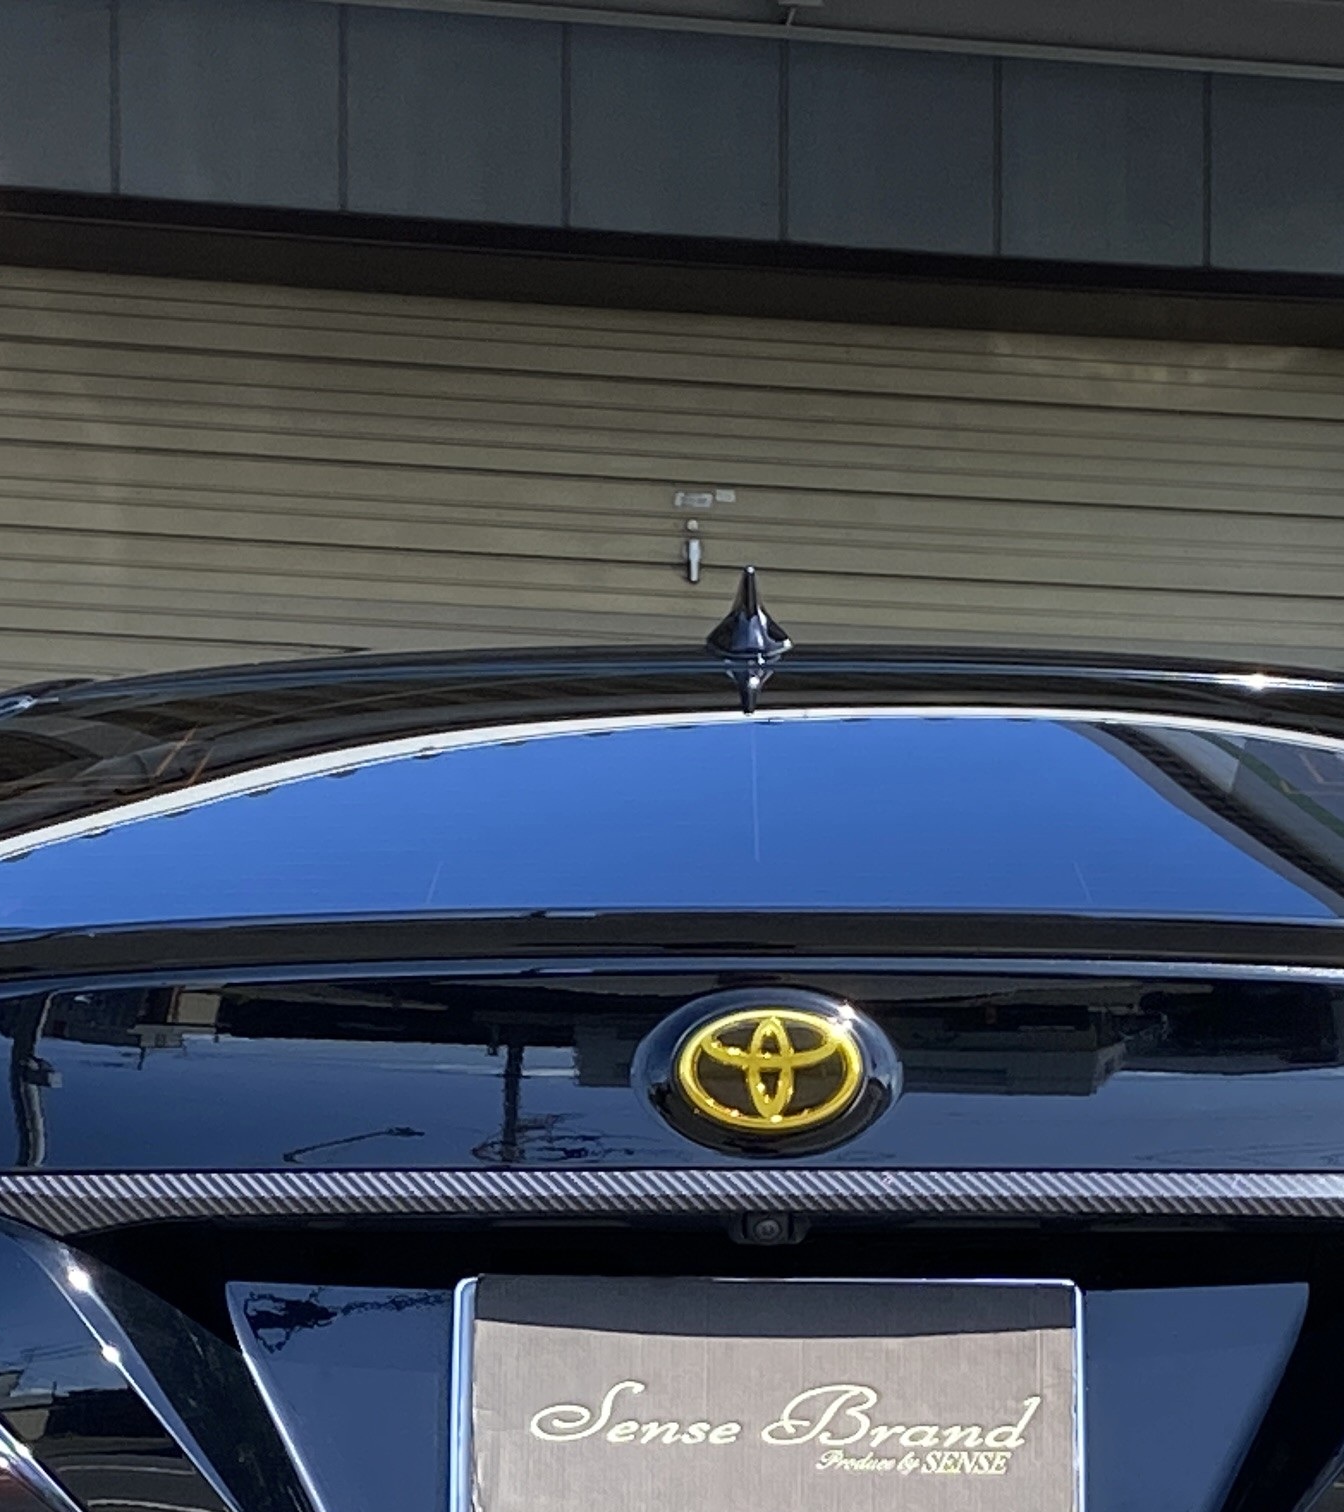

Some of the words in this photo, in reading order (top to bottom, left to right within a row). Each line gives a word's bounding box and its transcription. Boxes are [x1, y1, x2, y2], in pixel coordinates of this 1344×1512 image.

[530, 1380, 741, 1444] Sense
[761, 1384, 1042, 1448] Brand
[896, 1451, 920, 1475] by
[921, 1451, 1012, 1475] SENSE
